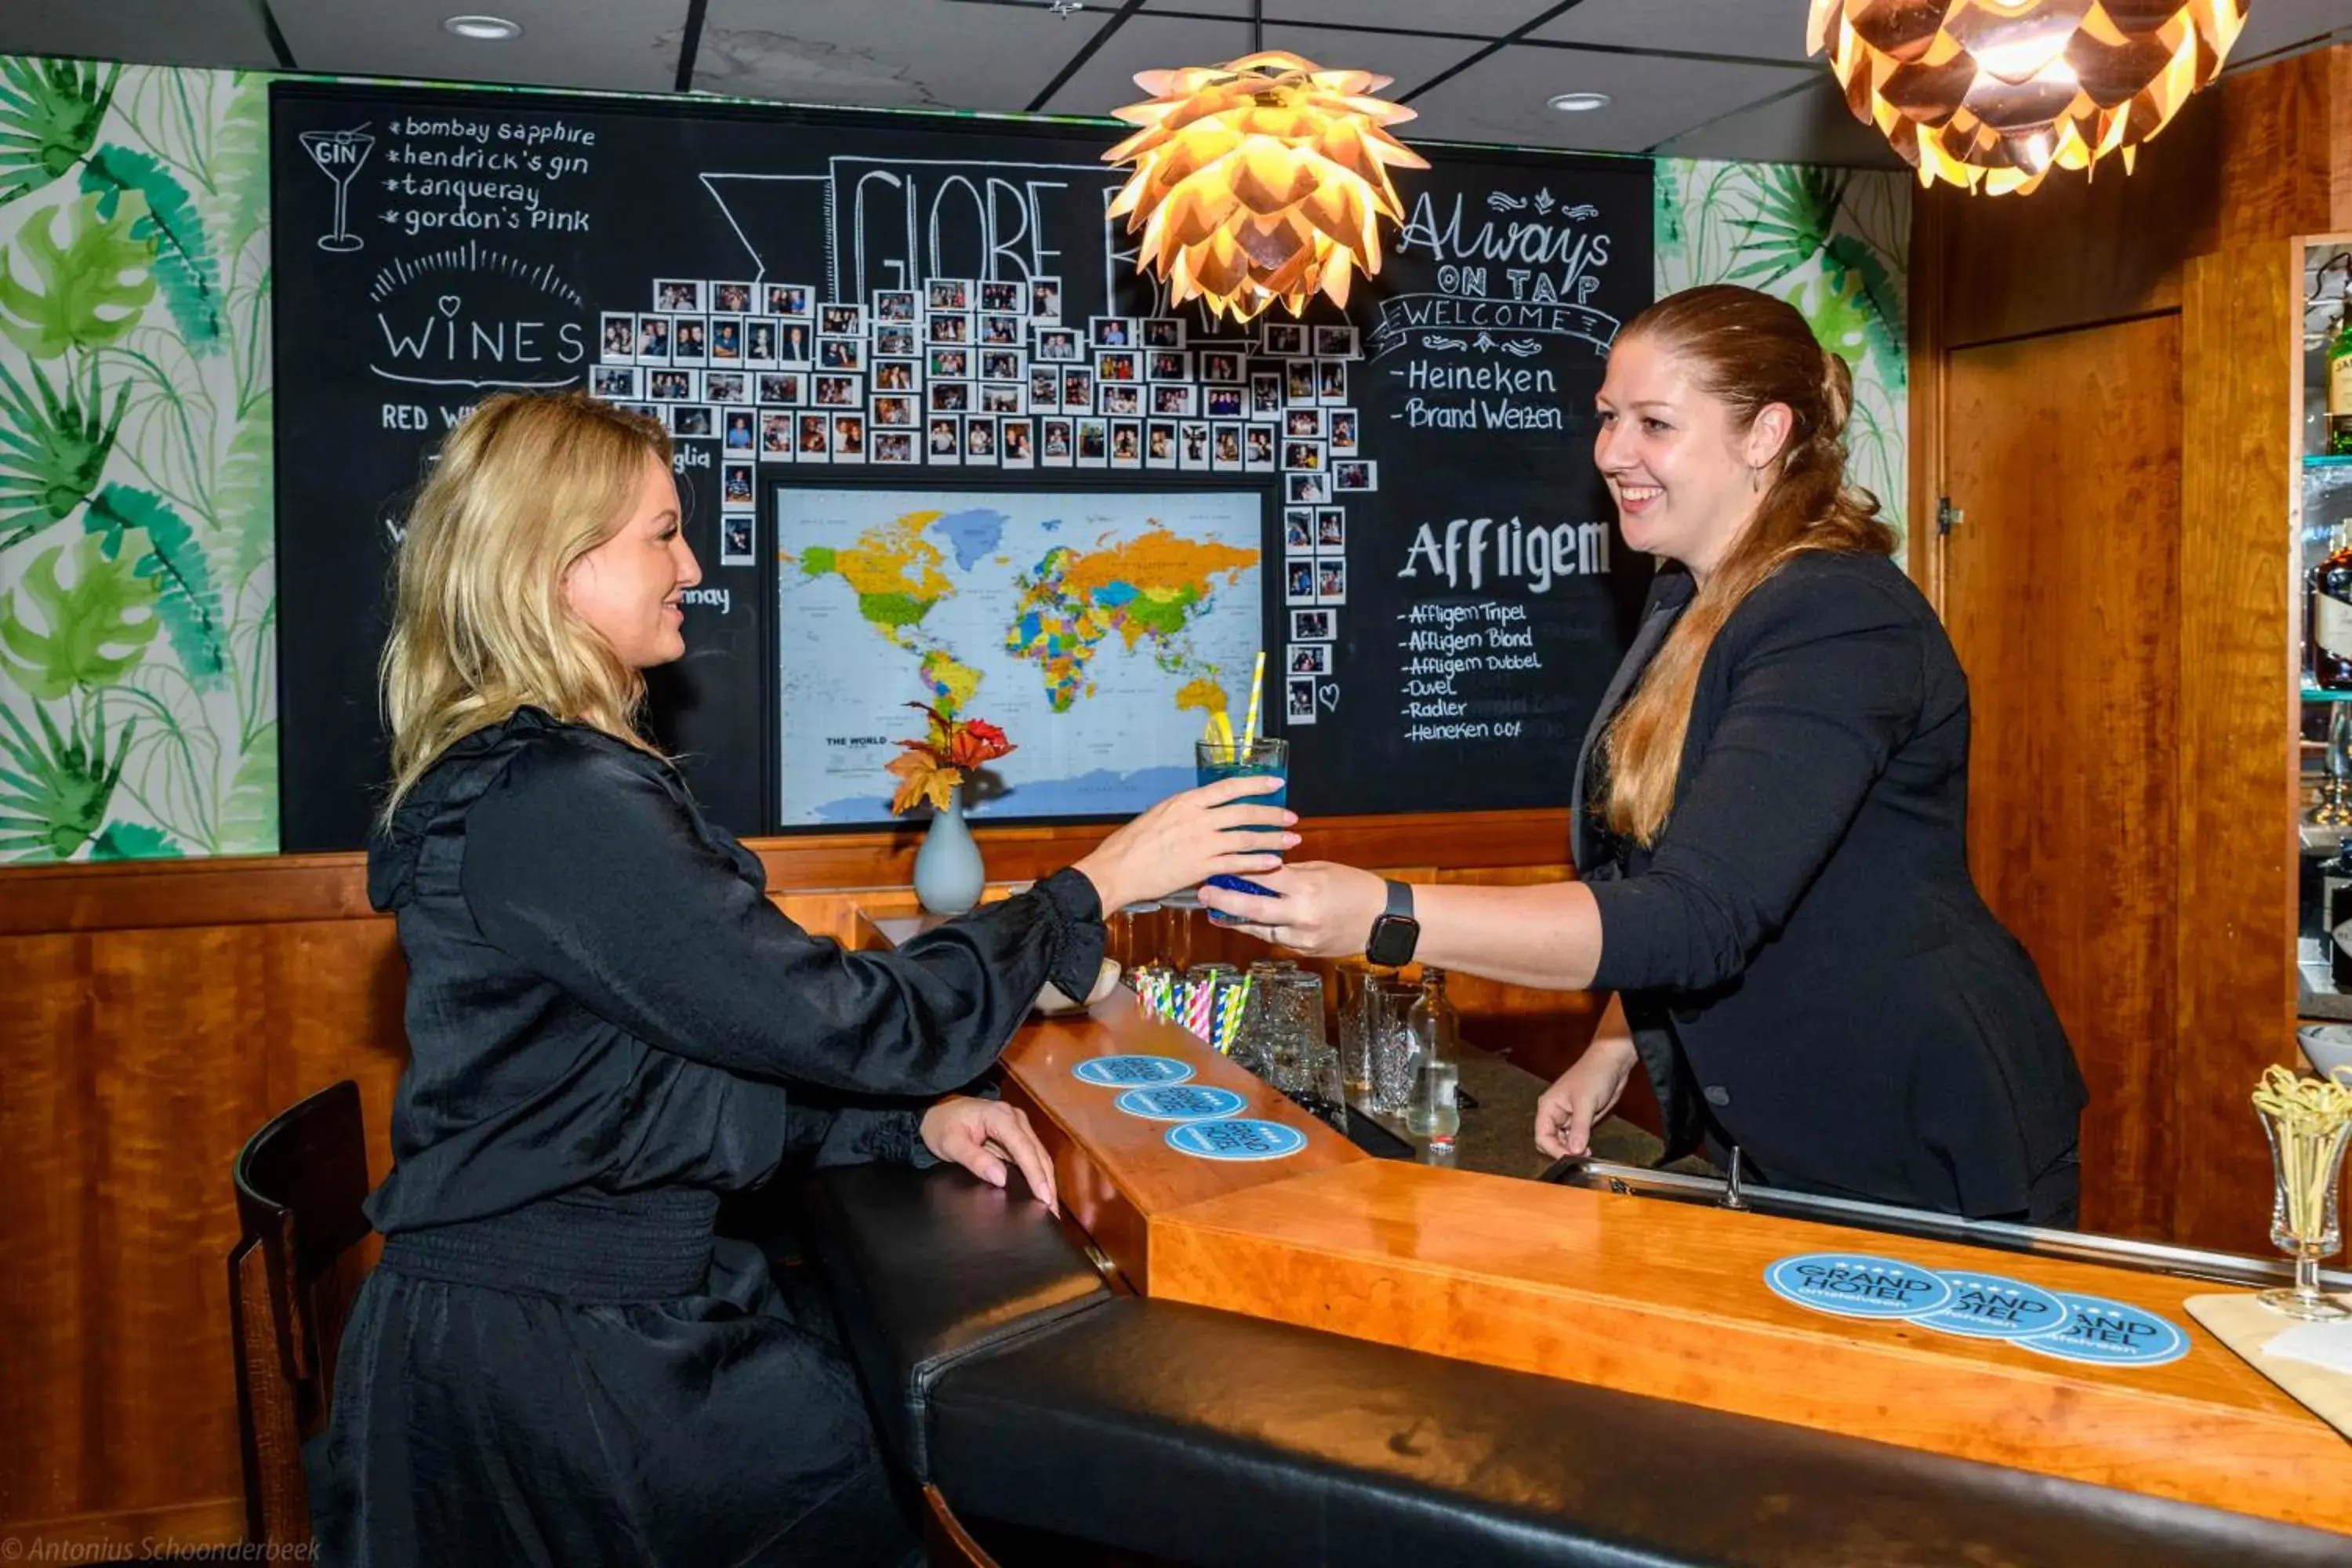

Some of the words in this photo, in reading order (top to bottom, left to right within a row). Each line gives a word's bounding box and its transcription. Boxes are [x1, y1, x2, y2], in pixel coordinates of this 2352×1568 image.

[496, 120, 596, 147] sapphire
[315, 142, 357, 164] GIN
[545, 155, 590, 181] gin
[401, 172, 540, 211] tanqueray
[1396, 191, 1611, 296] Always
[1437, 265, 1487, 296] ON
[1506, 269, 1600, 305] TAP
[1403, 300, 1571, 332] WELCOME
[383, 403, 429, 430] RED
[1483, 399, 1563, 430] Weizen
[673, 442, 710, 474] glia
[1397, 515, 1611, 593] Affligem
[1485, 626, 1533, 648] Blond
[826, 737, 846, 746] THE
[850, 736, 887, 746] WORLD
[1795, 1265, 1933, 1291] GRAND
[1802, 1276, 1912, 1302] HOTEL
[1951, 1299, 2024, 1323] OTEL
[1958, 1288, 2049, 1313] AND
[2062, 1325, 2140, 1348] OTEL
[2077, 1313, 2158, 1335] AND
